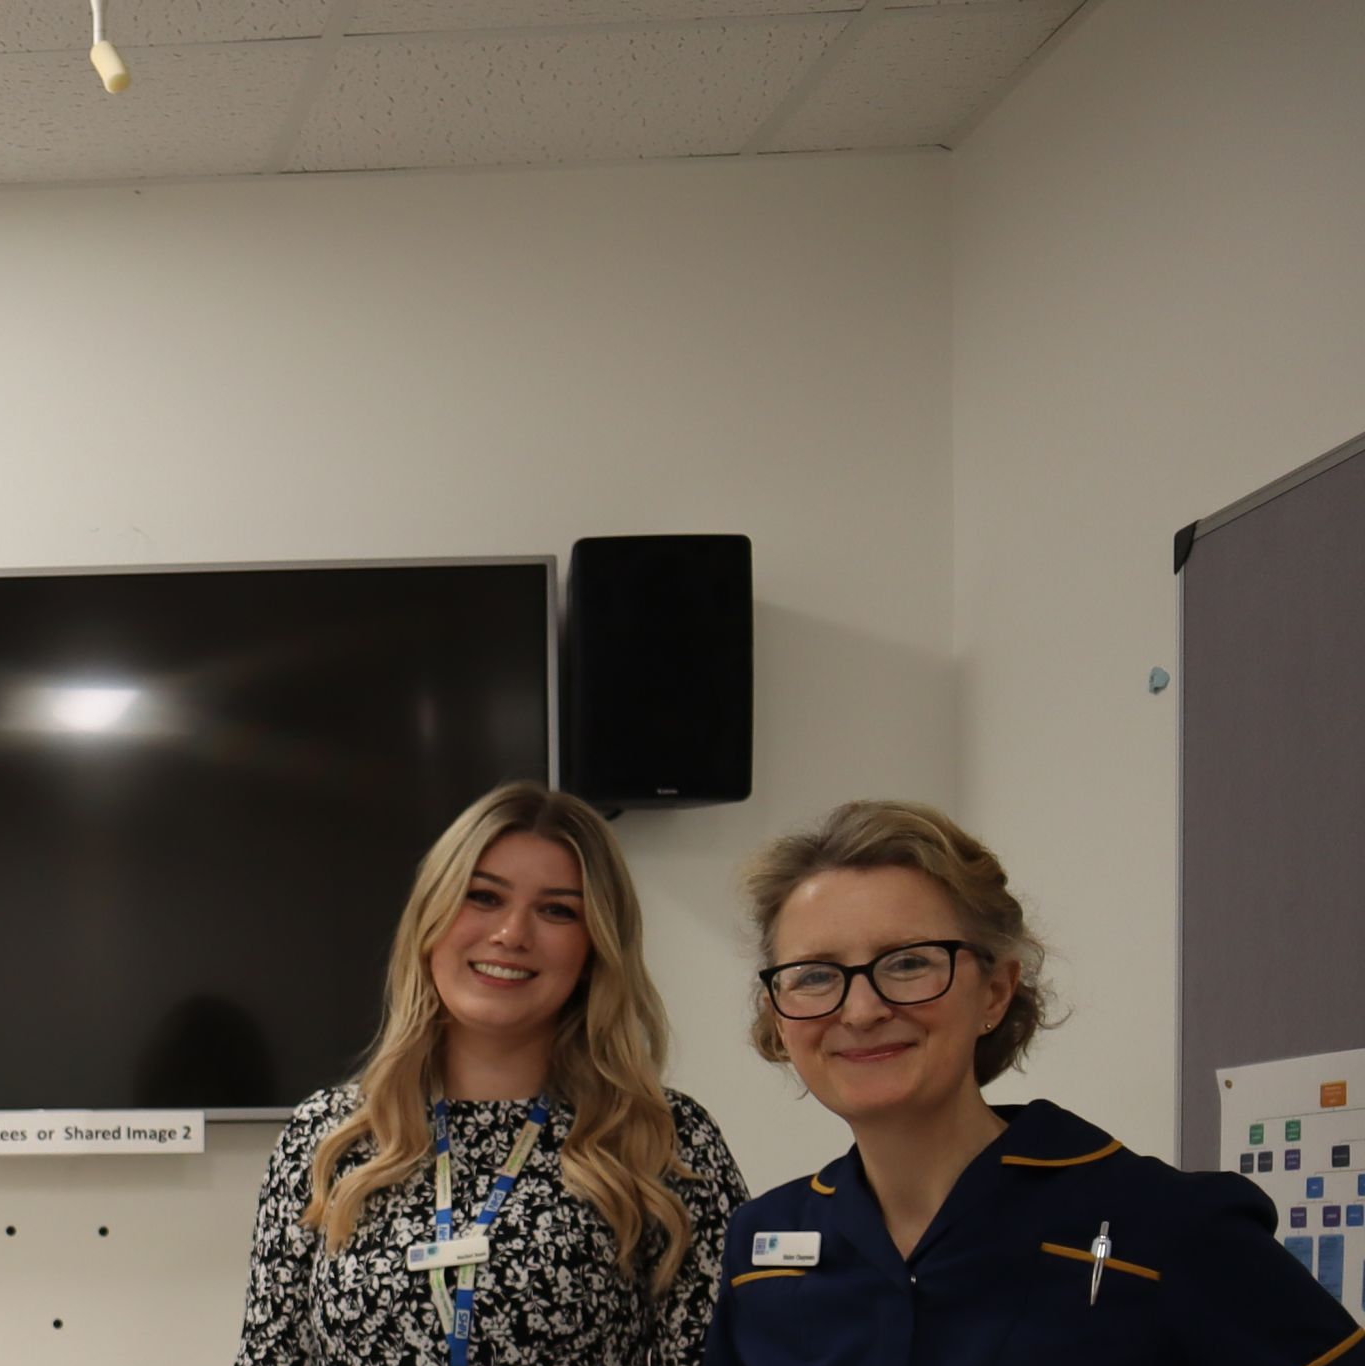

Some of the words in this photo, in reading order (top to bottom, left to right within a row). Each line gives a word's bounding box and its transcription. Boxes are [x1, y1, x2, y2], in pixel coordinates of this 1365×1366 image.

[37, 1129, 55, 1141] or
[64, 1126, 122, 1141] Shared
[127, 1126, 177, 1143] Image
[182, 1125, 192, 1140] 2
[456, 1312, 469, 1337] NHS
